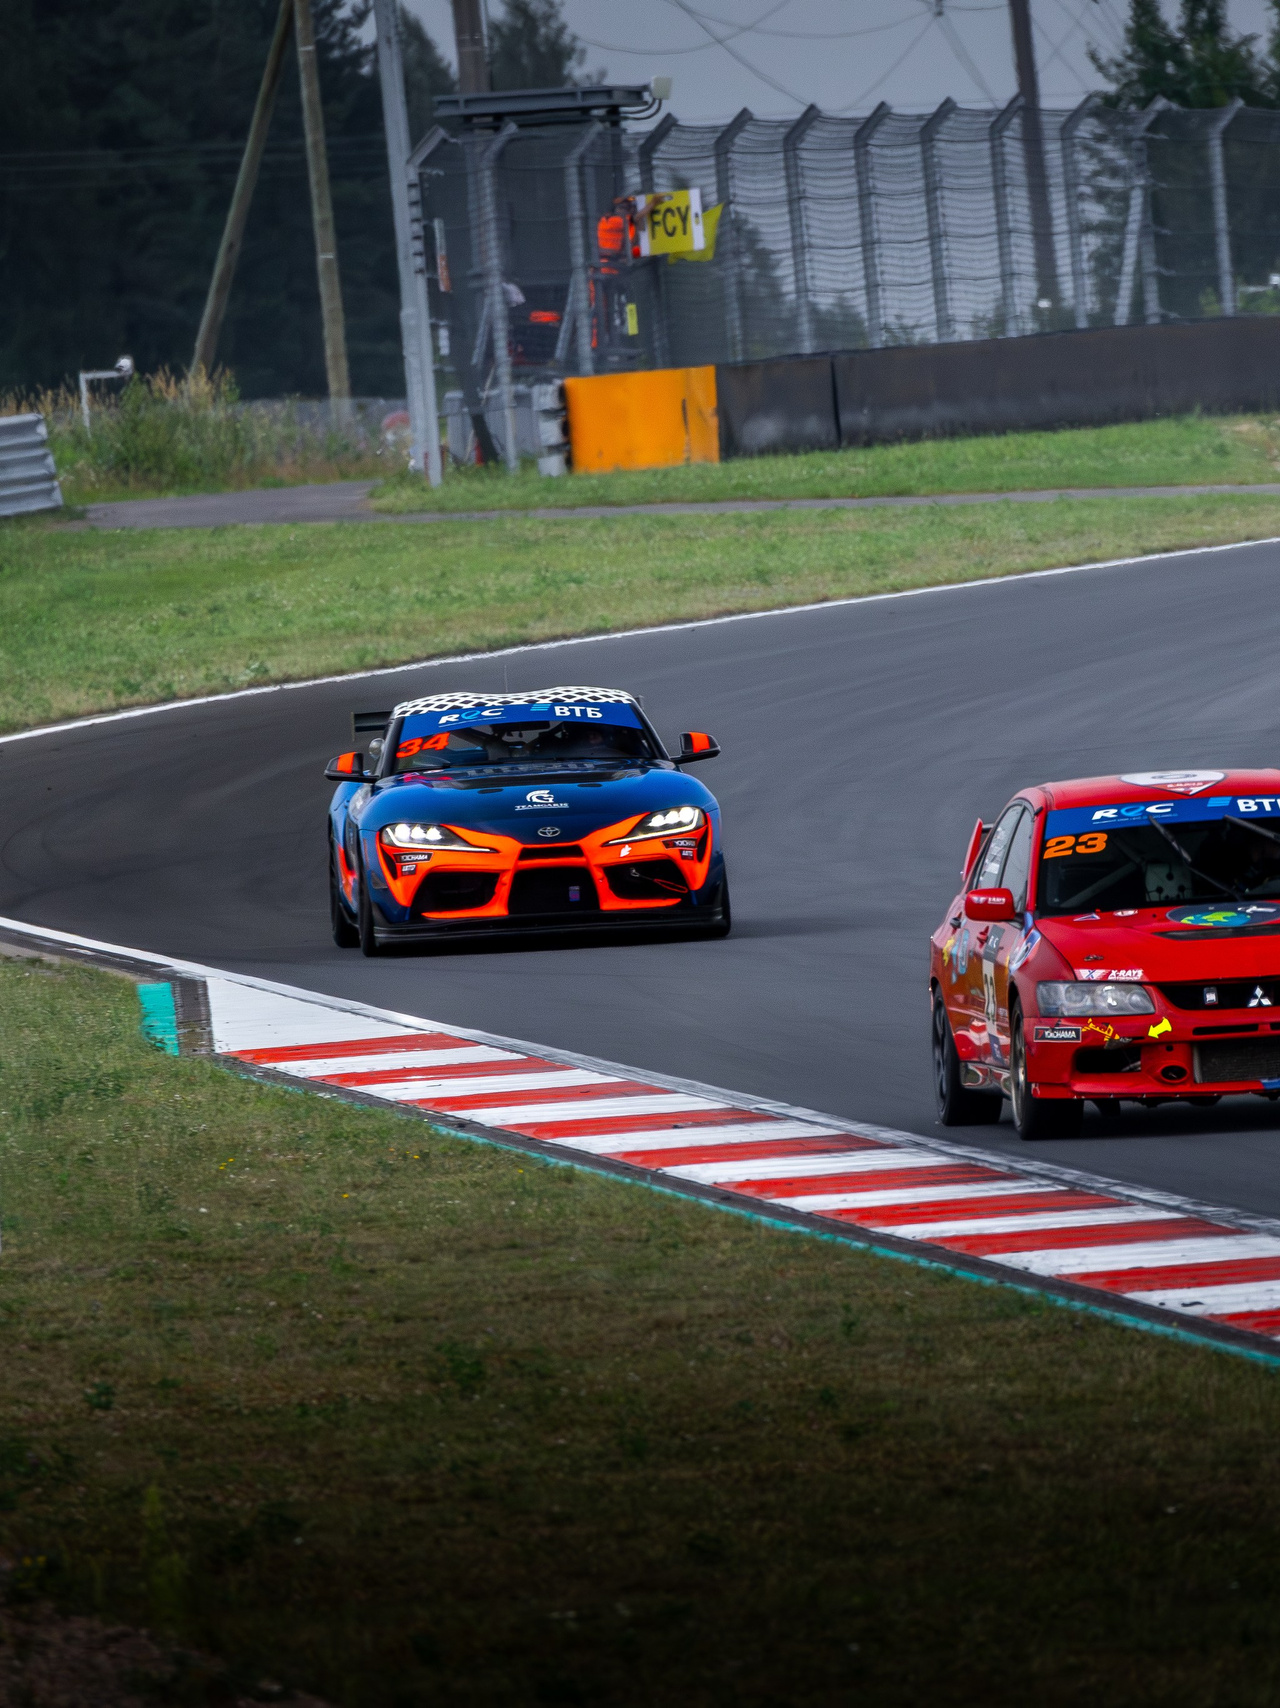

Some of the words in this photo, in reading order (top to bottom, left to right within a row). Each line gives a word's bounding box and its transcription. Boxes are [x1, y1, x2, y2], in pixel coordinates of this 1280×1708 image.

[650, 205, 690, 240] FCY
[554, 705, 603, 718] ВТБ
[396, 731, 450, 759] 34
[1043, 832, 1108, 860] 23
[1108, 969, 1143, 979] X-RAYS
[1044, 1030, 1077, 1038] YOKOHAMA
